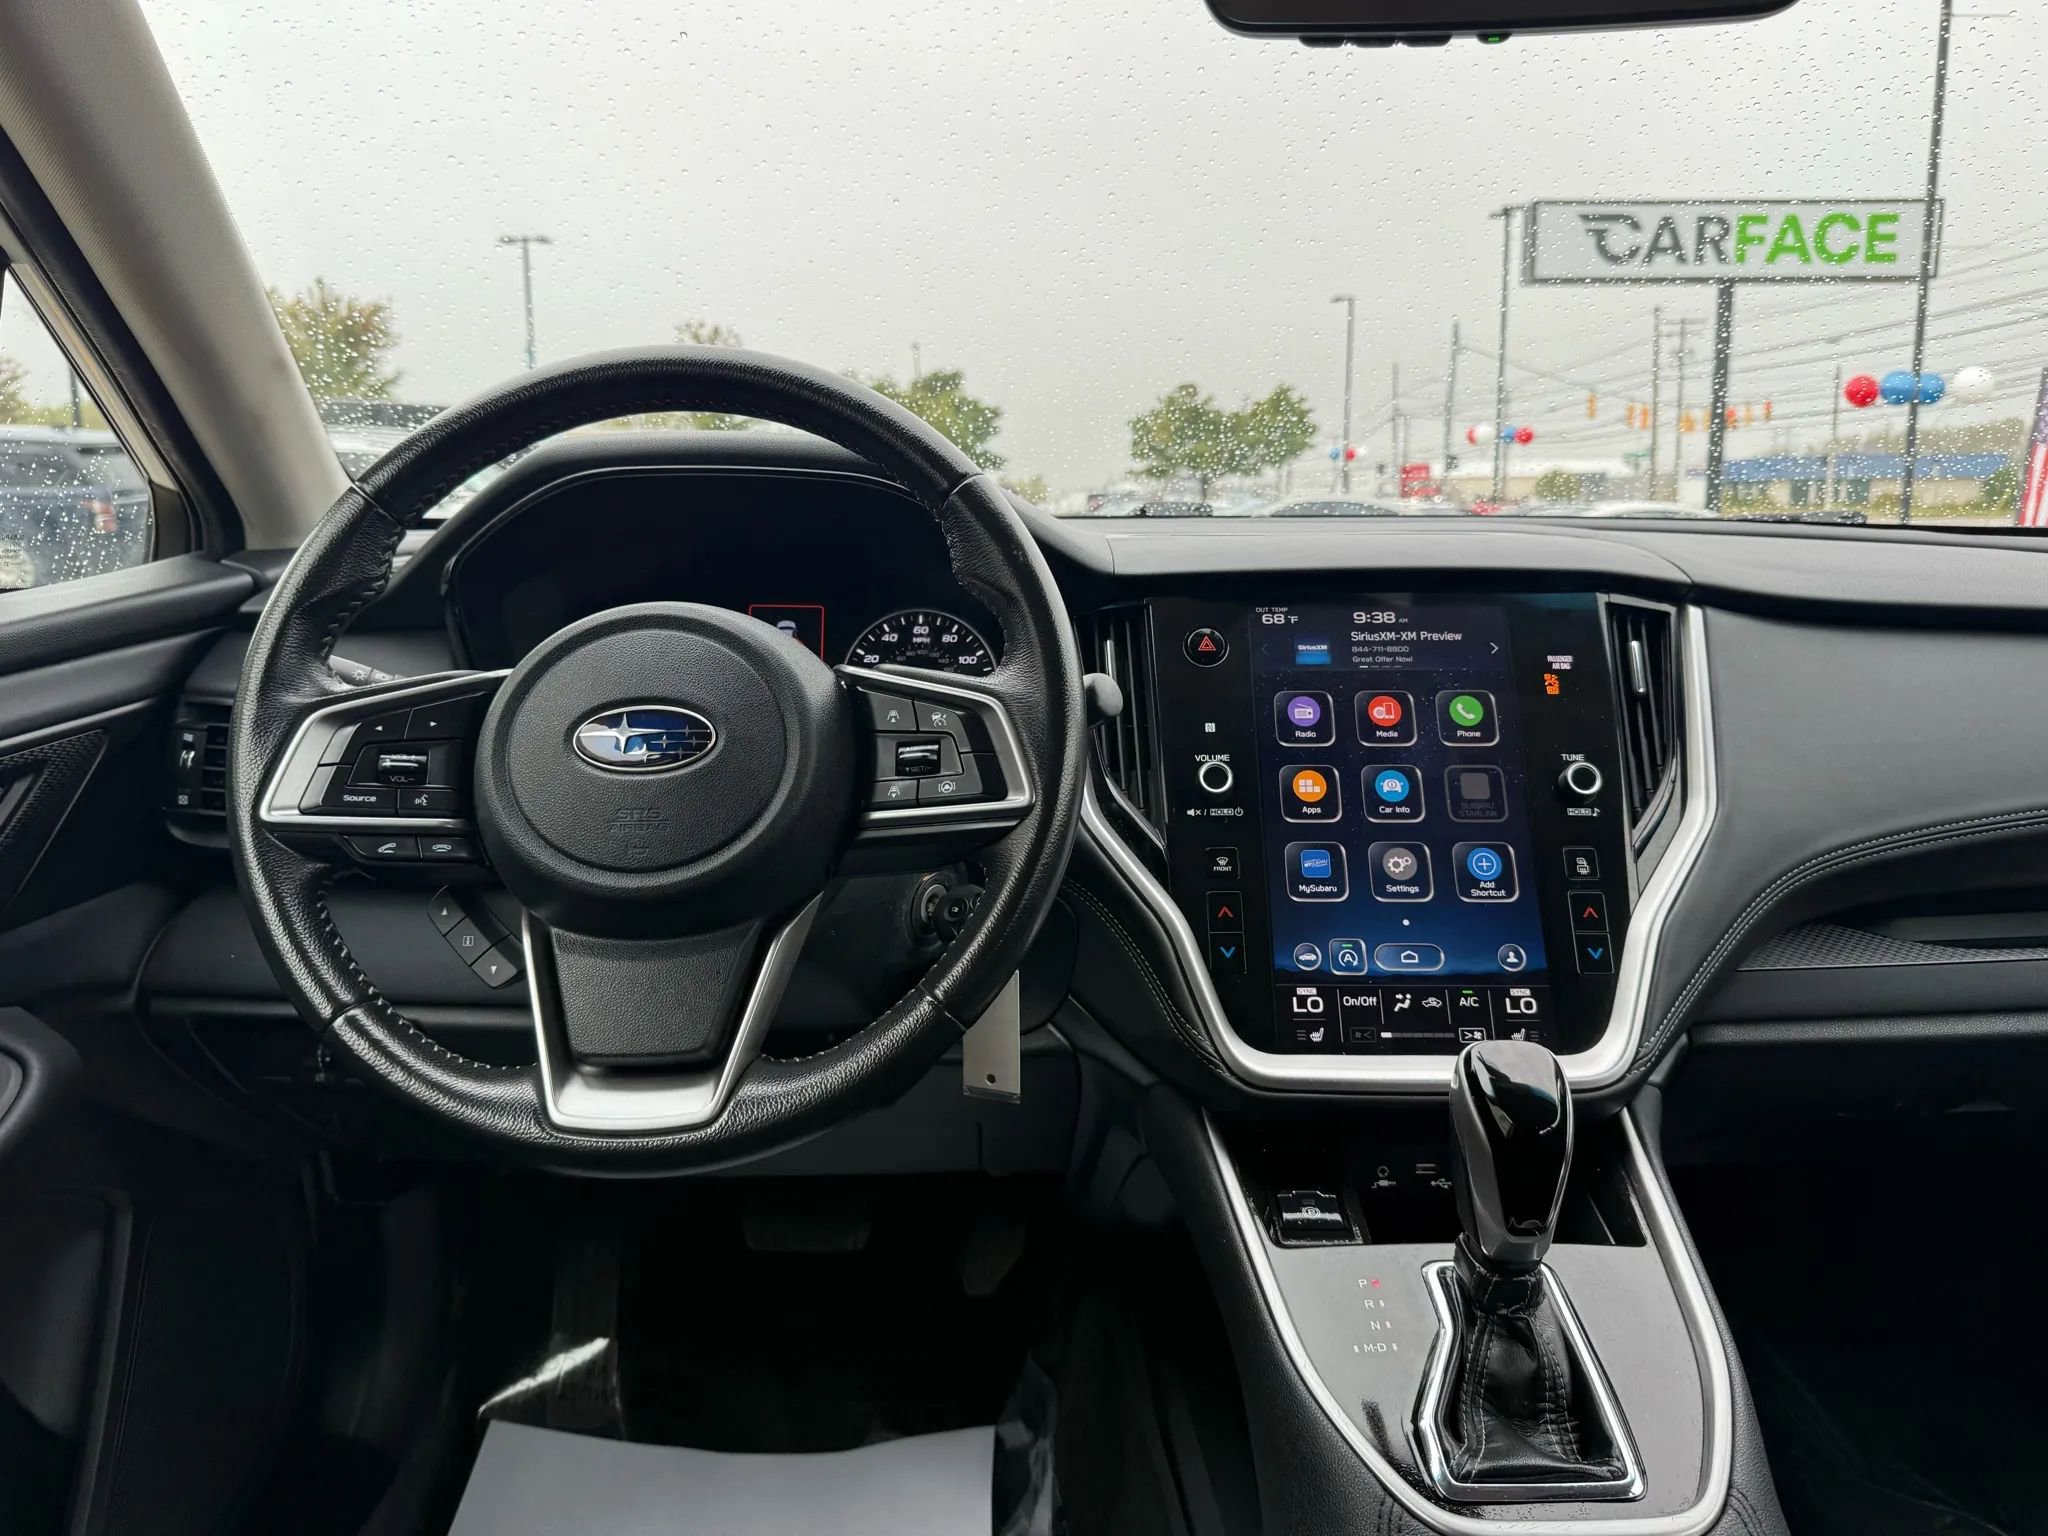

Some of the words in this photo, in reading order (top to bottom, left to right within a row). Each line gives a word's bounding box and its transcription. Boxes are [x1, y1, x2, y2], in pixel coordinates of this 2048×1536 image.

[1578, 213, 1900, 266] CARFACE
[1262, 614, 1285, 624] 68
[1353, 611, 1396, 624] 9:38
[914, 626, 929, 634] 60
[881, 634, 898, 642] 40
[942, 635, 958, 643] 80
[1350, 631, 1417, 641] SiriusXM-XM
[1420, 631, 1463, 641] Preview
[863, 655, 879, 663] 20
[958, 656, 977, 664] 100
[1352, 655, 1373, 663] Great
[1375, 655, 1393, 663] Offer
[1395, 655, 1413, 663] Now!
[1295, 730, 1316, 738] Radio
[1376, 730, 1398, 738] Media
[1457, 730, 1481, 738] Phone
[1195, 754, 1230, 762] VOLUME
[1561, 753, 1585, 761] TUNE
[343, 794, 377, 802] Source
[1210, 808, 1234, 816] HOLD
[1302, 806, 1321, 815] Apps
[1379, 806, 1393, 814] Car
[1395, 806, 1410, 814] Info
[1567, 808, 1592, 816] HOLD
[1299, 885, 1337, 893] MySubaru
[1386, 884, 1420, 894] Settings
[1470, 889, 1506, 897] Shortcut
[1293, 997, 1325, 1013] LO
[1343, 996, 1377, 1007] On/Off
[1459, 997, 1479, 1007] A/C
[1505, 998, 1538, 1014] LO
[1358, 1279, 1368, 1288] P
[1364, 1299, 1374, 1309] R
[1370, 1321, 1380, 1330] N
